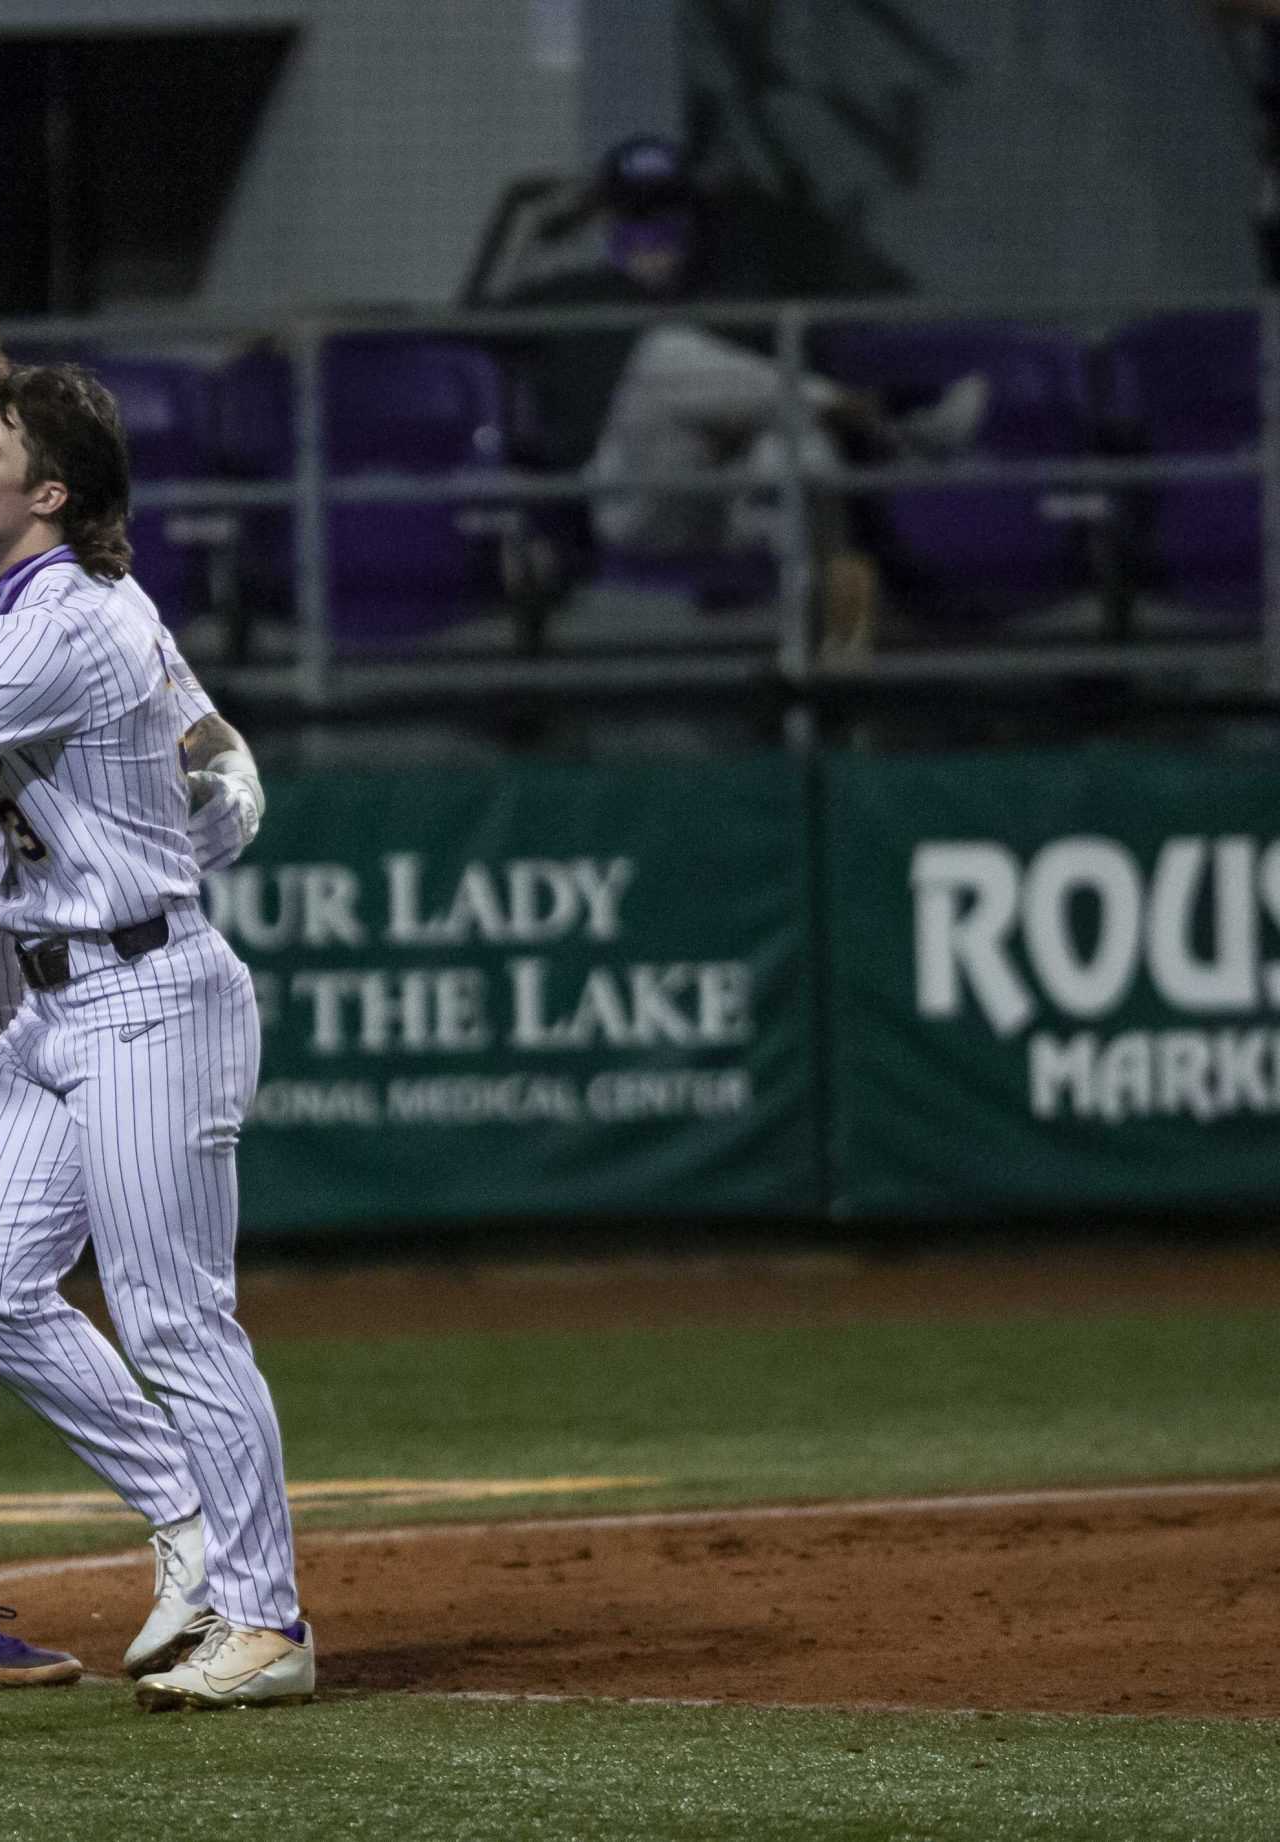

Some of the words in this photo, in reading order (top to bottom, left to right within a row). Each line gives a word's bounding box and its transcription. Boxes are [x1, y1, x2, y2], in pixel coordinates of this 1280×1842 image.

[381, 852, 636, 945] LADY
[910, 835, 1280, 1038] ROU
[290, 970, 489, 1052] THE
[507, 957, 754, 1049] LAKE
[388, 1074, 579, 1122] MEDICAL
[1027, 1029, 1280, 1122] MARK
